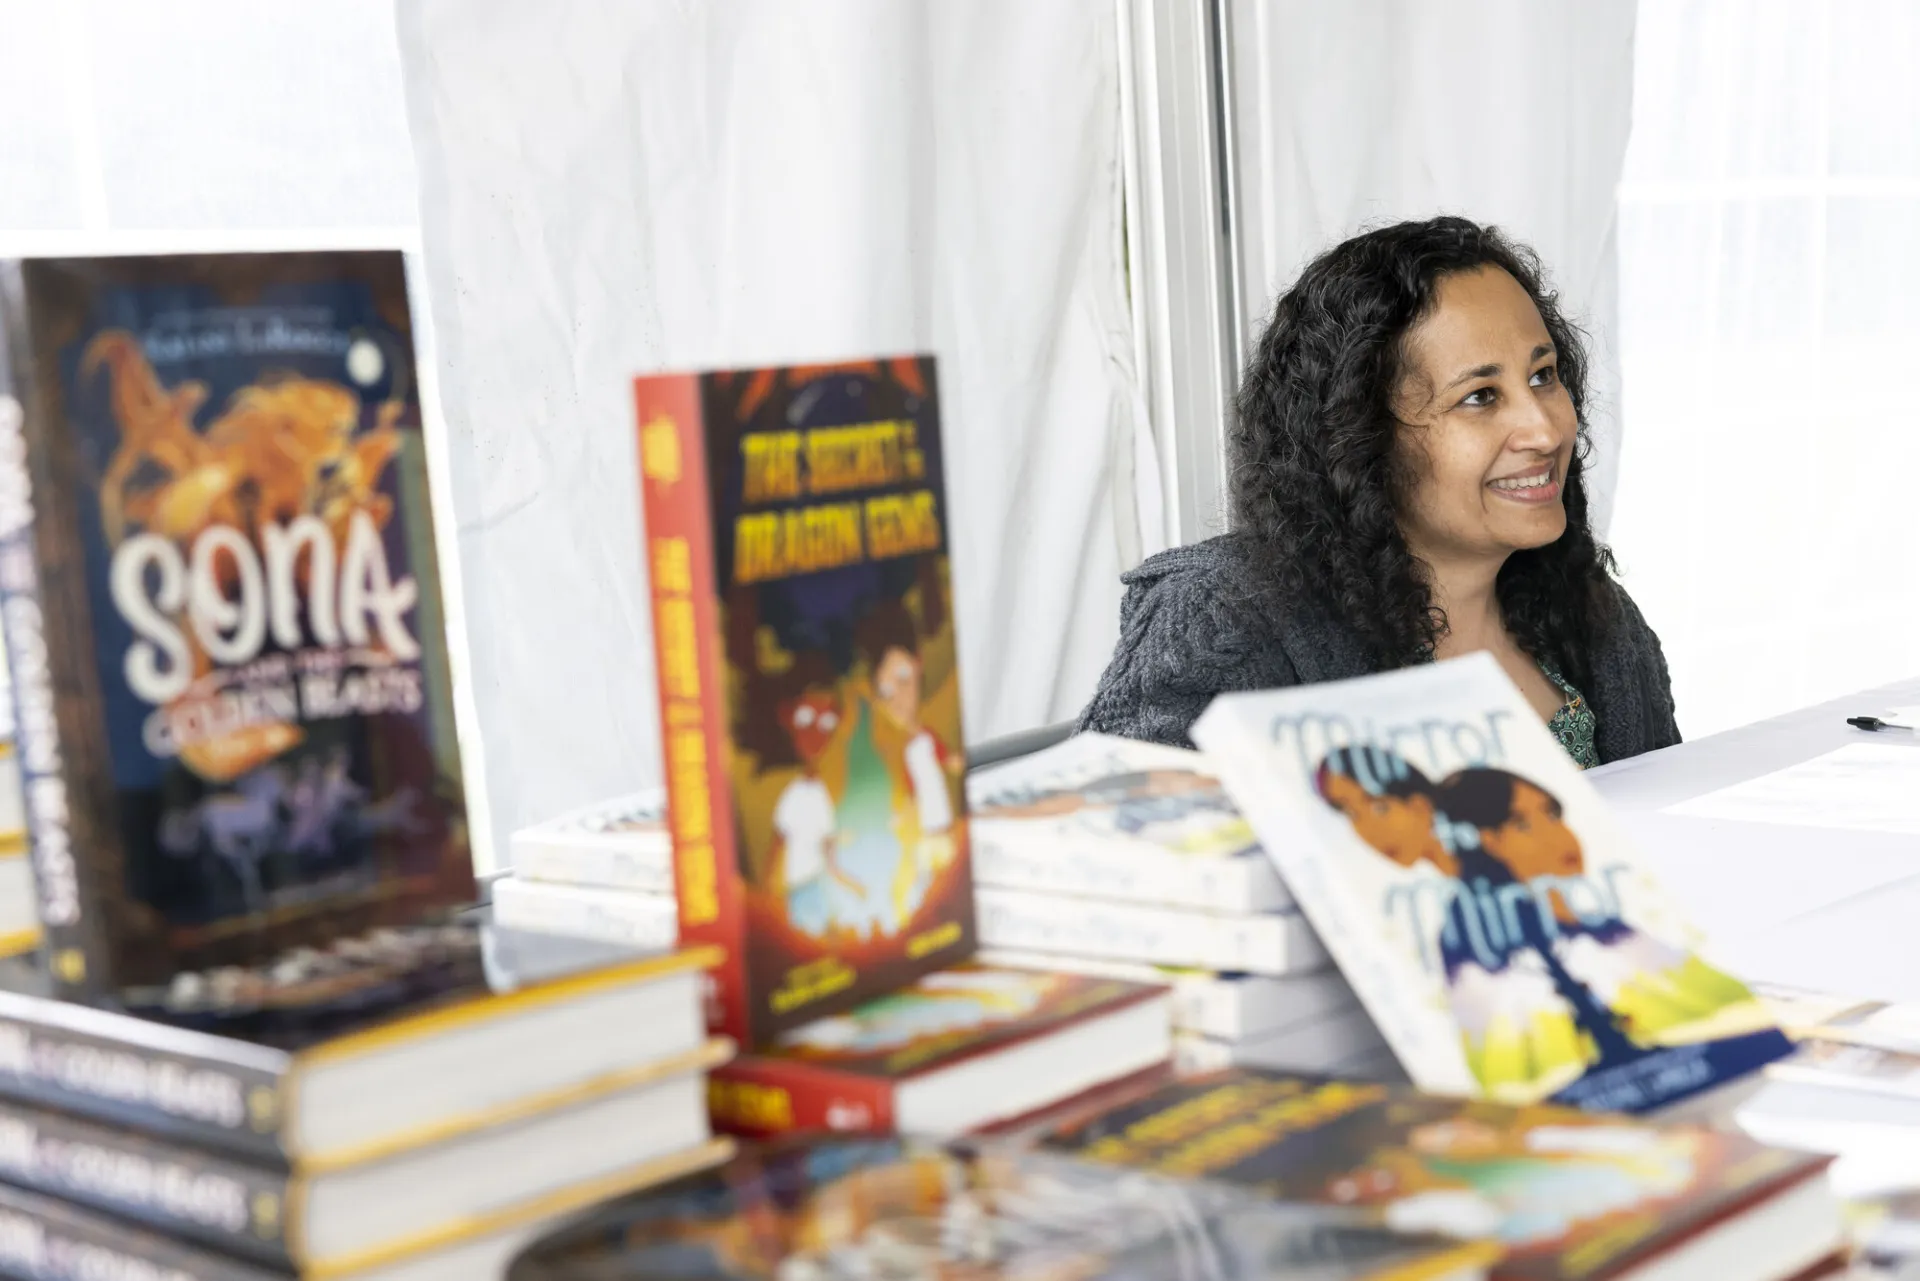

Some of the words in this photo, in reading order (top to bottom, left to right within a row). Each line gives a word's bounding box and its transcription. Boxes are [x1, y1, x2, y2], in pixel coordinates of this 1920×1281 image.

[740, 429, 802, 504] THE
[806, 419, 901, 495] SECRET
[732, 502, 864, 586] DRAGON
